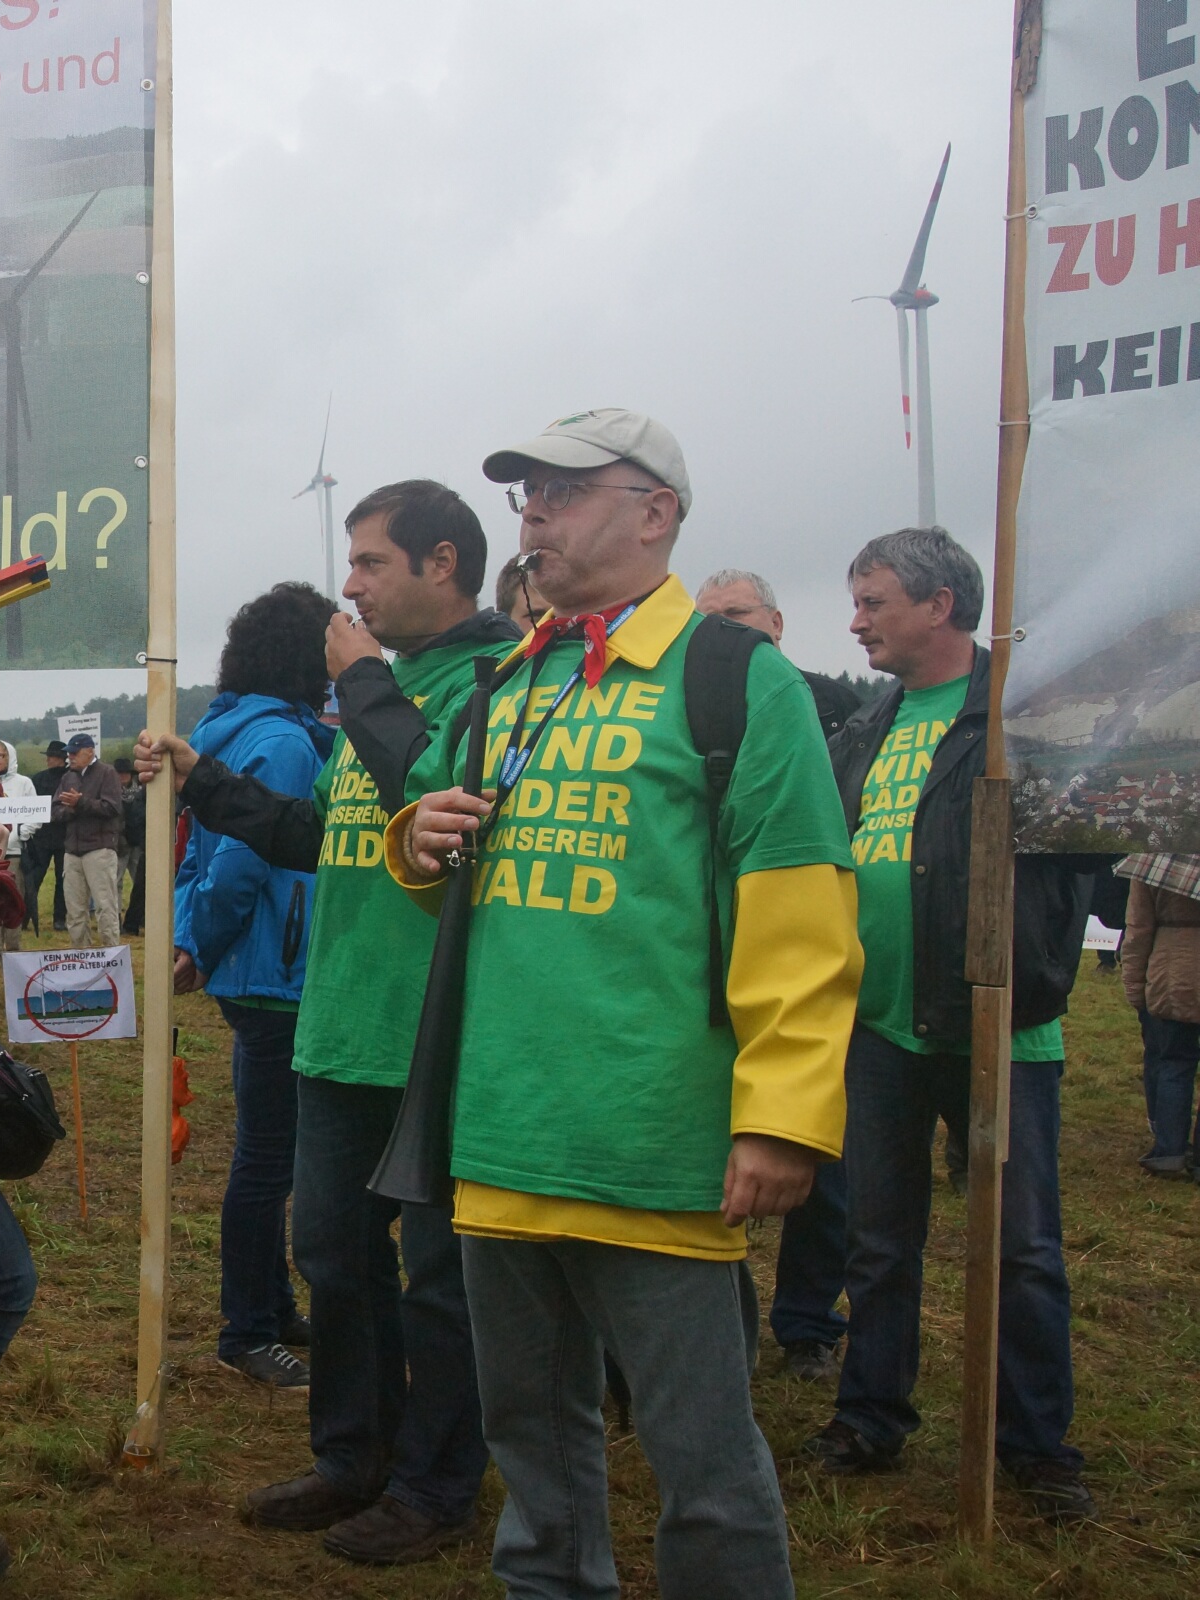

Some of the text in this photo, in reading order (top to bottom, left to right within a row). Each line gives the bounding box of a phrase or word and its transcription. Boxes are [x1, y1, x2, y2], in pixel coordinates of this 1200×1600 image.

[22, 37, 120, 94] und
[1045, 213, 1137, 293] ZU
[488, 680, 665, 728] KEINE
[8, 805, 47, 815] Nordbayern
[318, 830, 384, 868] ALD
[486, 826, 627, 860] UNSEREM
[43, 951, 106, 961] KEIN WINDPARK
[44, 964, 59, 972] AUF
[62, 963, 77, 971] DER
[79, 960, 118, 970] ALTEBURG
